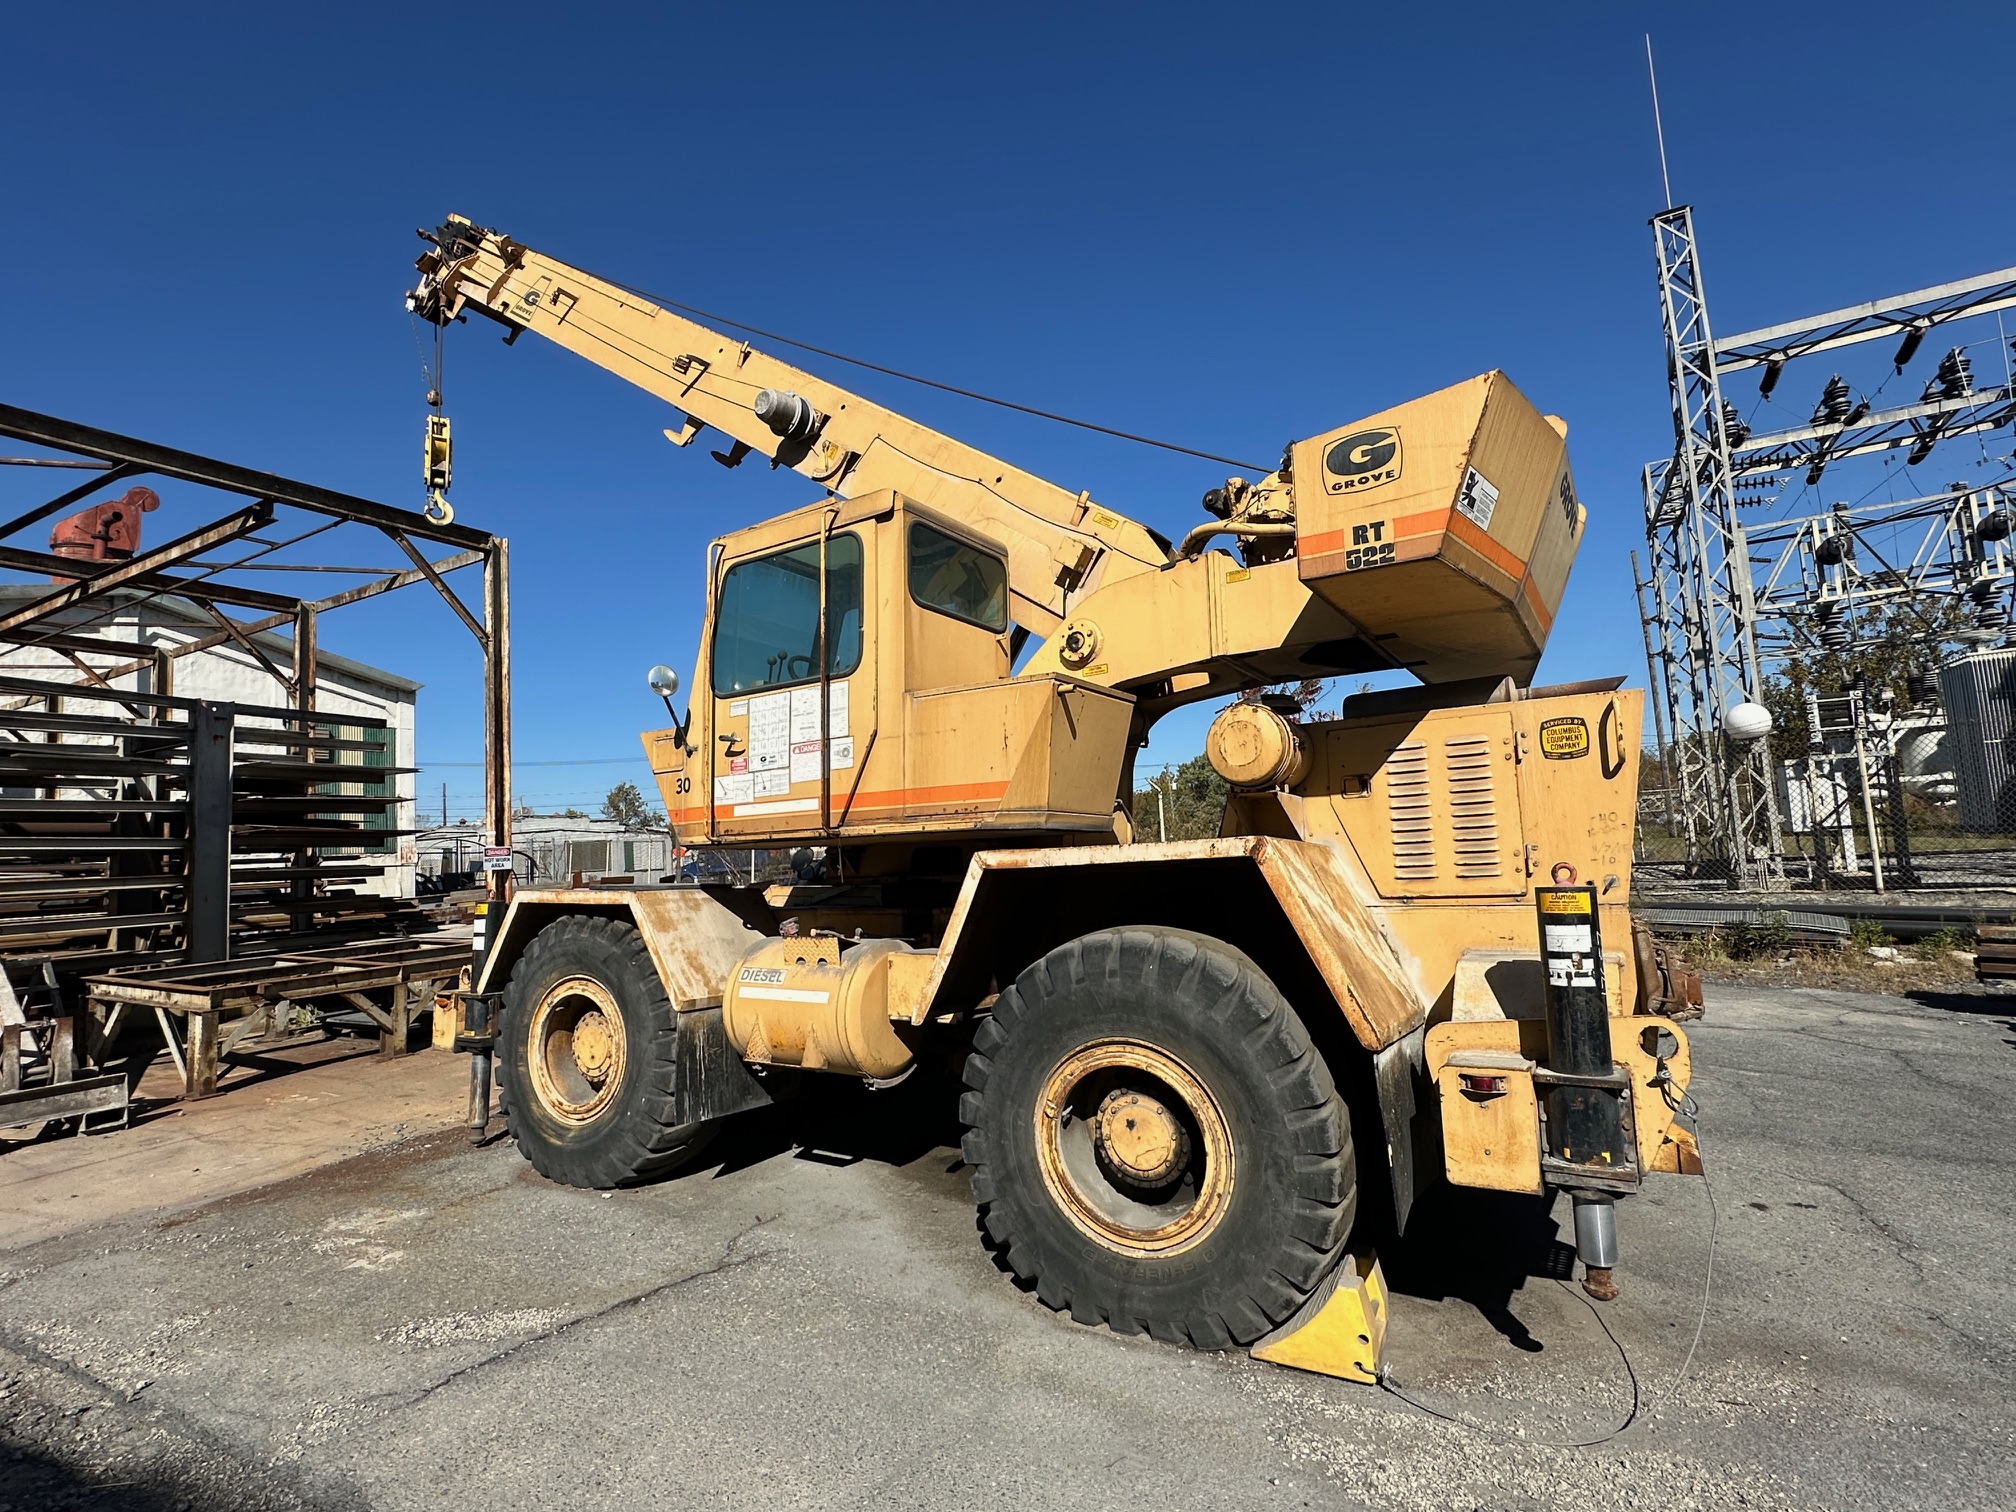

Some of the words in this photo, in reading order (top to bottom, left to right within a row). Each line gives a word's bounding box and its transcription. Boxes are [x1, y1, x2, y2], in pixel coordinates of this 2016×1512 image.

[524, 290, 540, 306] G
[1326, 431, 1396, 476] G
[1331, 469, 1396, 491] GROVE
[1560, 471, 1578, 540] GROVE
[1352, 521, 1385, 546] RT
[1345, 542, 1396, 570] 522
[1543, 718, 1572, 728] SERVICED
[1546, 726, 1581, 736] COLUMBUS
[1546, 734, 1583, 744] EQUIPMENT
[1550, 742, 1581, 751] COMPANY
[800, 743, 821, 753] DANGE
[675, 777, 691, 795] 30
[741, 969, 783, 983] DIESEL
